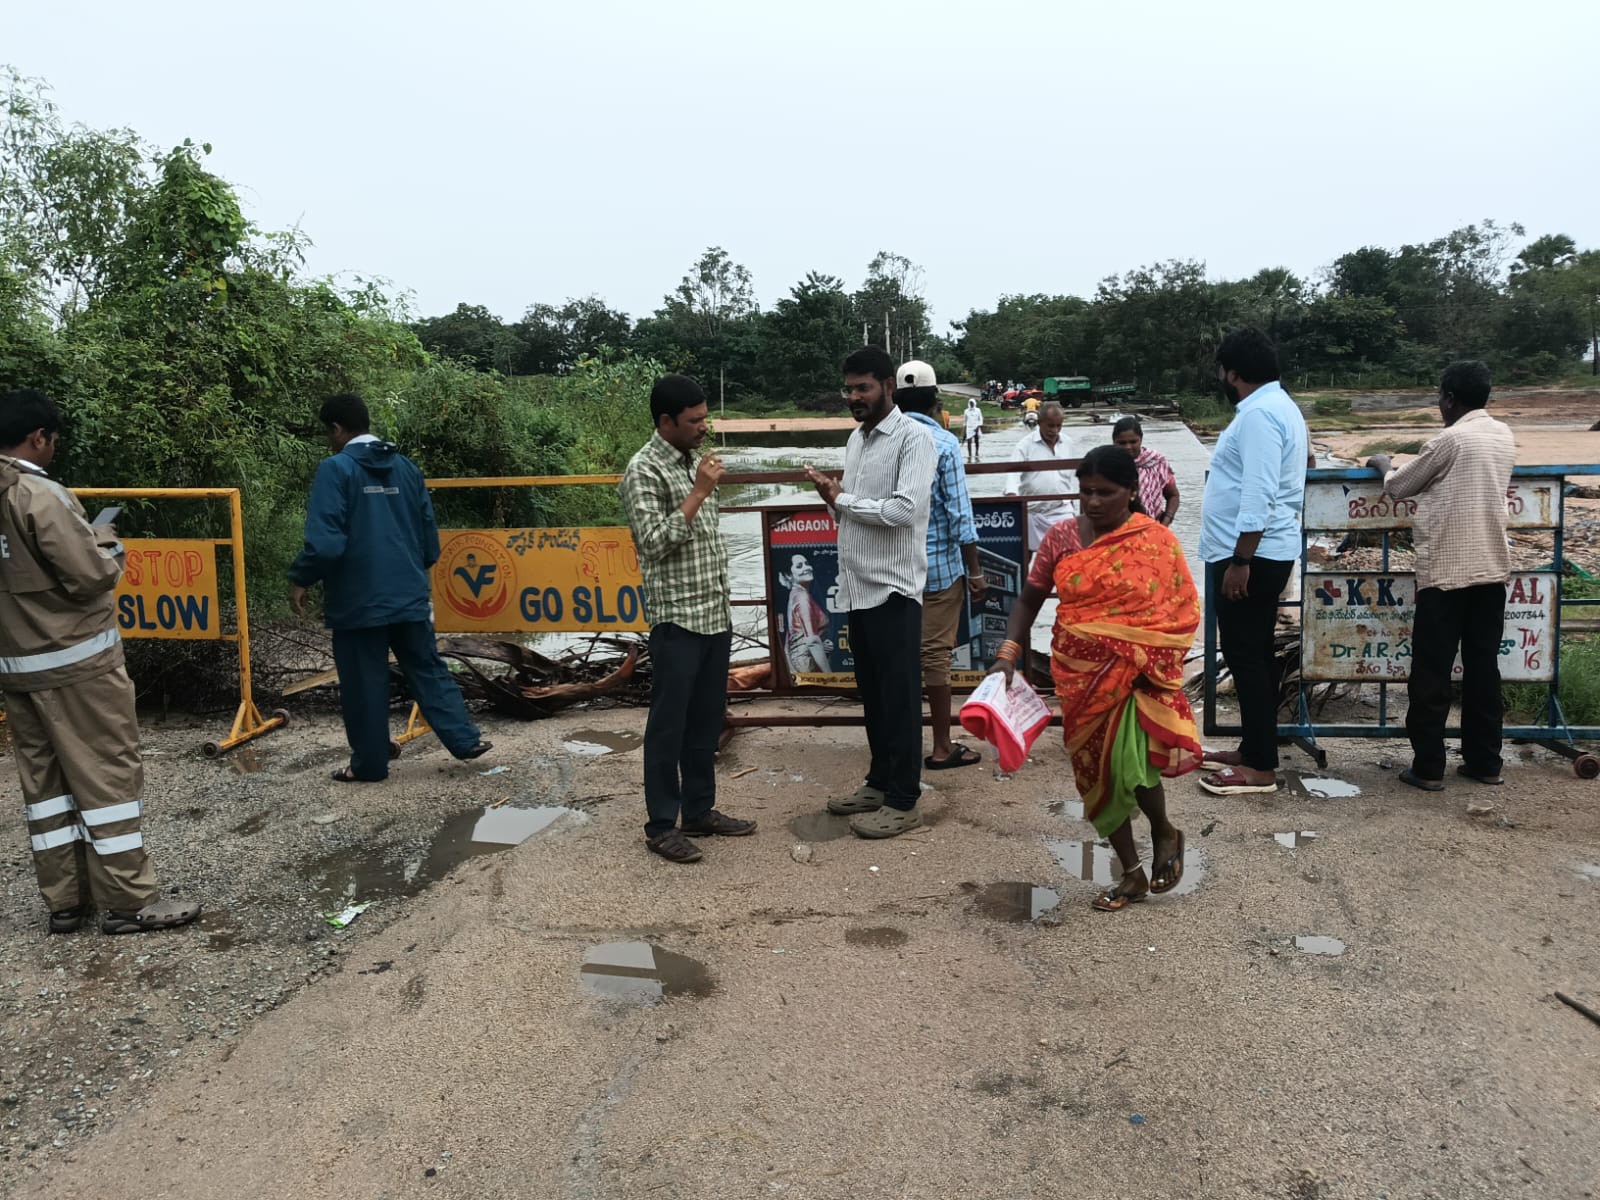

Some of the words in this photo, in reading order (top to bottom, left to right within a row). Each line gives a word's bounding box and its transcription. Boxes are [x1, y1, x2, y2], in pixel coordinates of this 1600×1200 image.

[973, 511, 1016, 529] పోలీస్
[1349, 491, 1418, 519] జనగా
[125, 549, 203, 588] STOP
[581, 540, 639, 577] STO
[118, 594, 209, 631] SLOW
[519, 585, 564, 623] GO
[1523, 649, 1541, 670] 16
